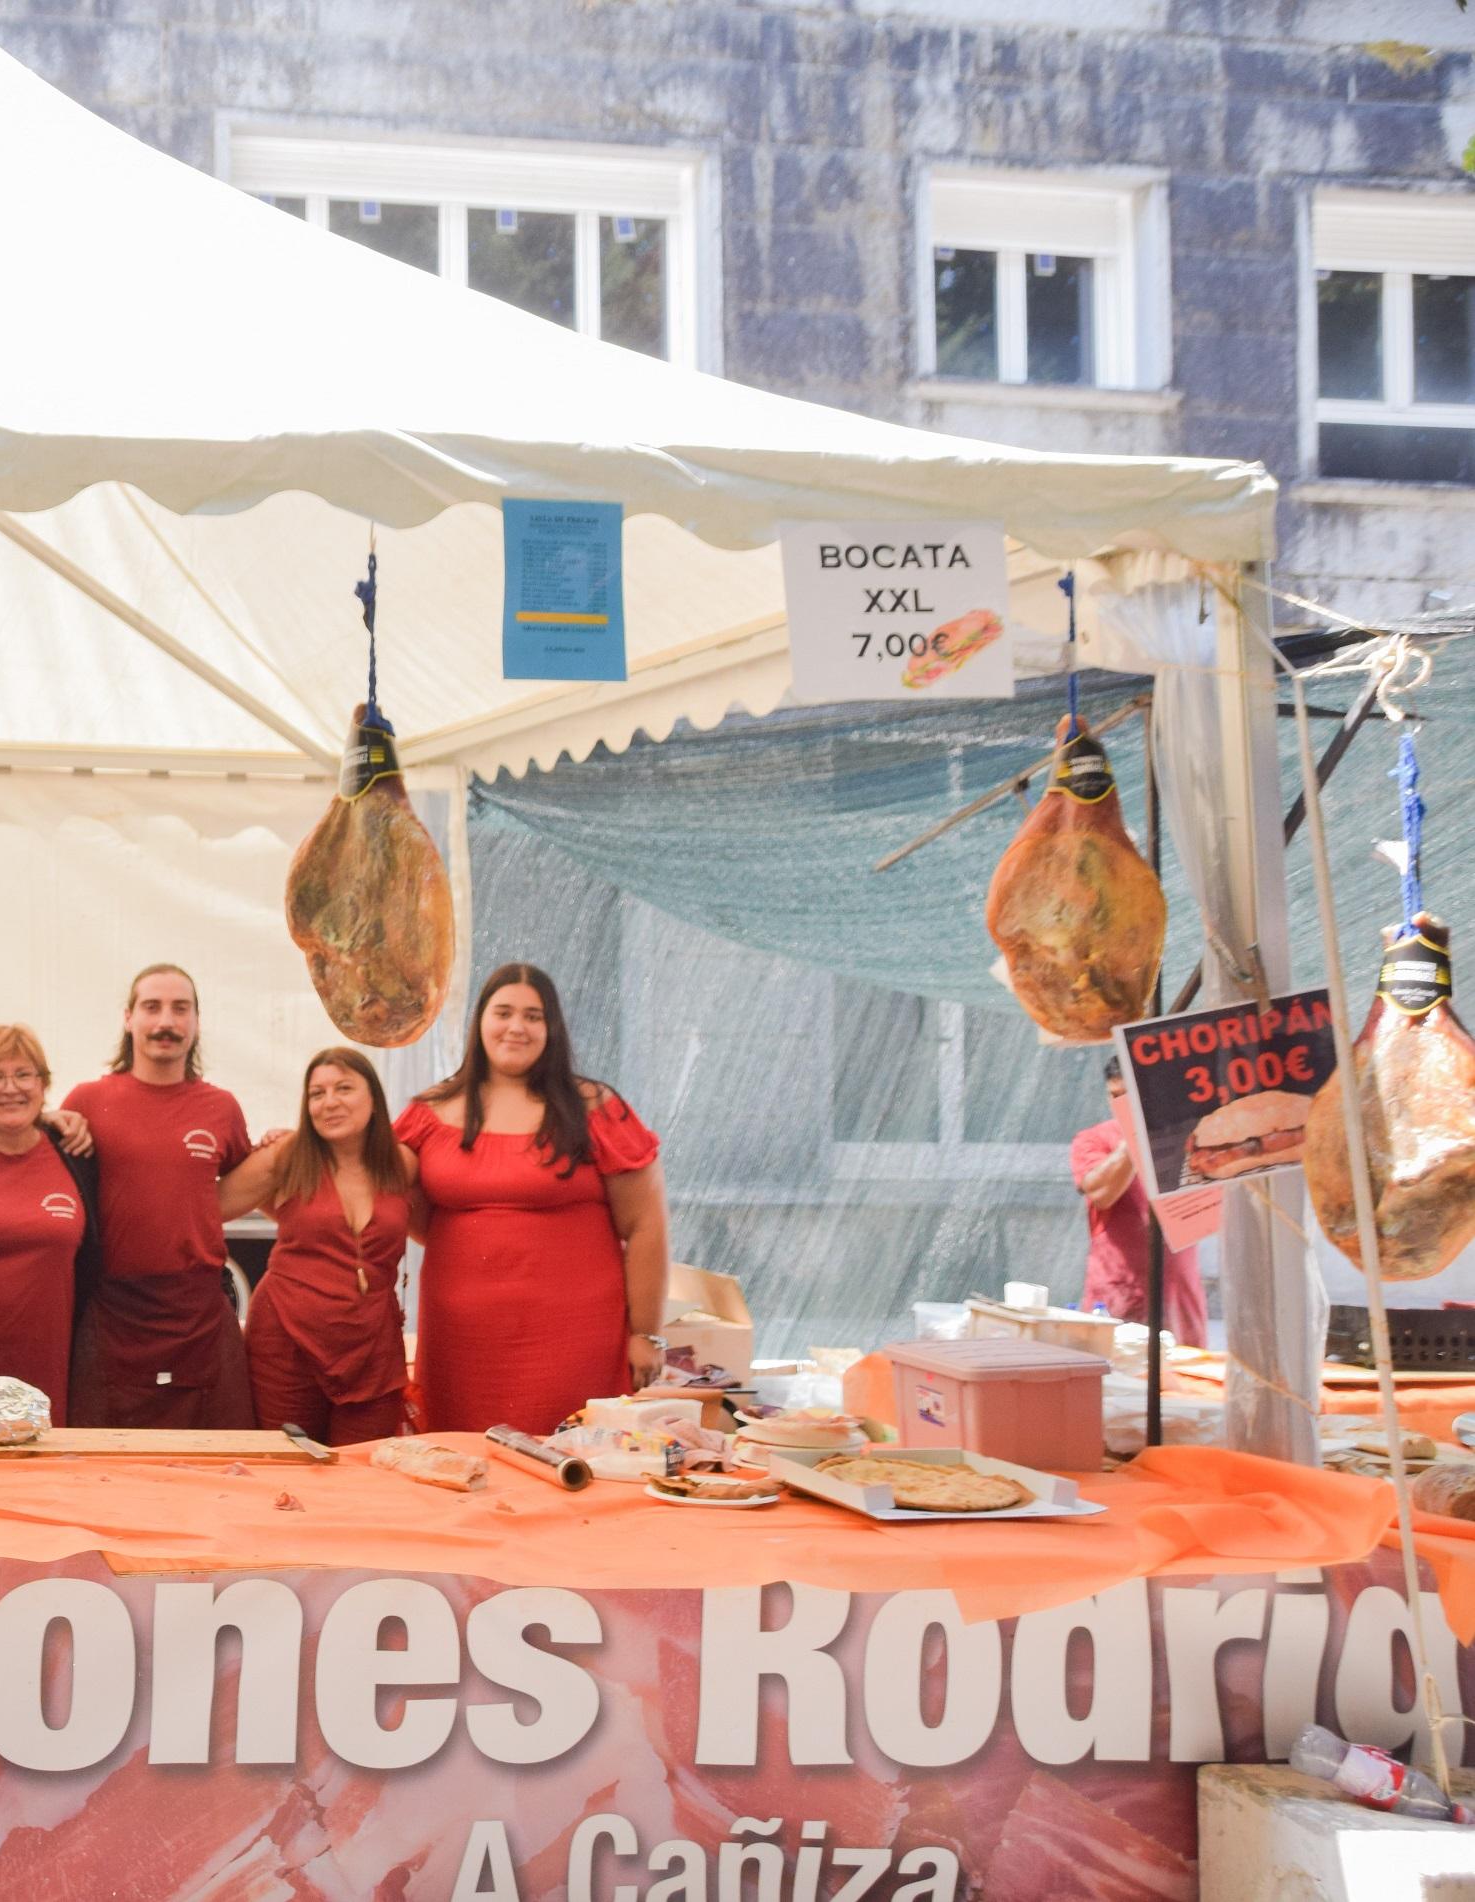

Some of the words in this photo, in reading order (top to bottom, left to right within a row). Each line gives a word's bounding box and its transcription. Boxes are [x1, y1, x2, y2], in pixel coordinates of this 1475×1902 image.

[819, 544, 971, 568] BOCATA
[863, 588, 935, 613] XXL
[851, 632, 954, 663] 7,00€
[1184, 1046, 1315, 1106] 3,00€
[449, 1820, 522, 1902] A
